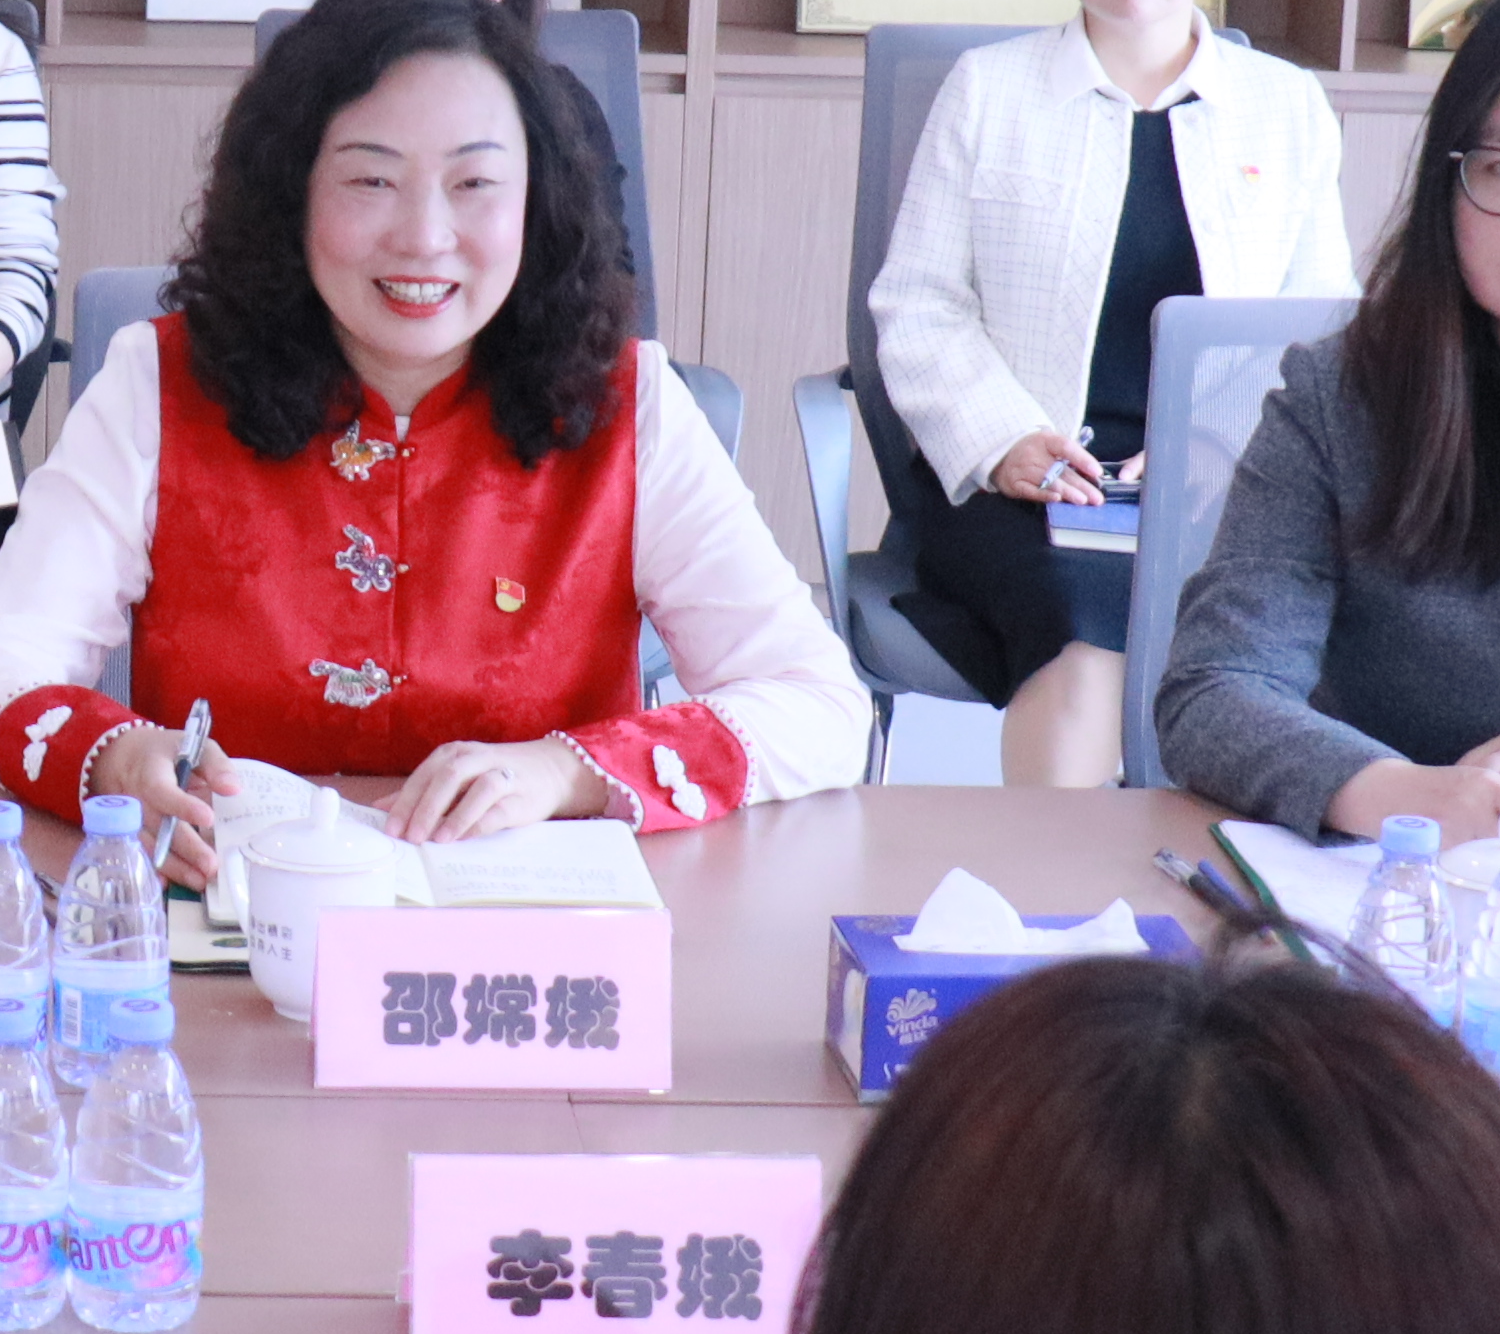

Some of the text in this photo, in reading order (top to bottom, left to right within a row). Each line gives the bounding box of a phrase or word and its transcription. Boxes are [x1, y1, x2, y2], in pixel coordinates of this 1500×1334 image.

[381, 971, 620, 1051] 邵嫦娥
[486, 1228, 764, 1322] 李春娥
